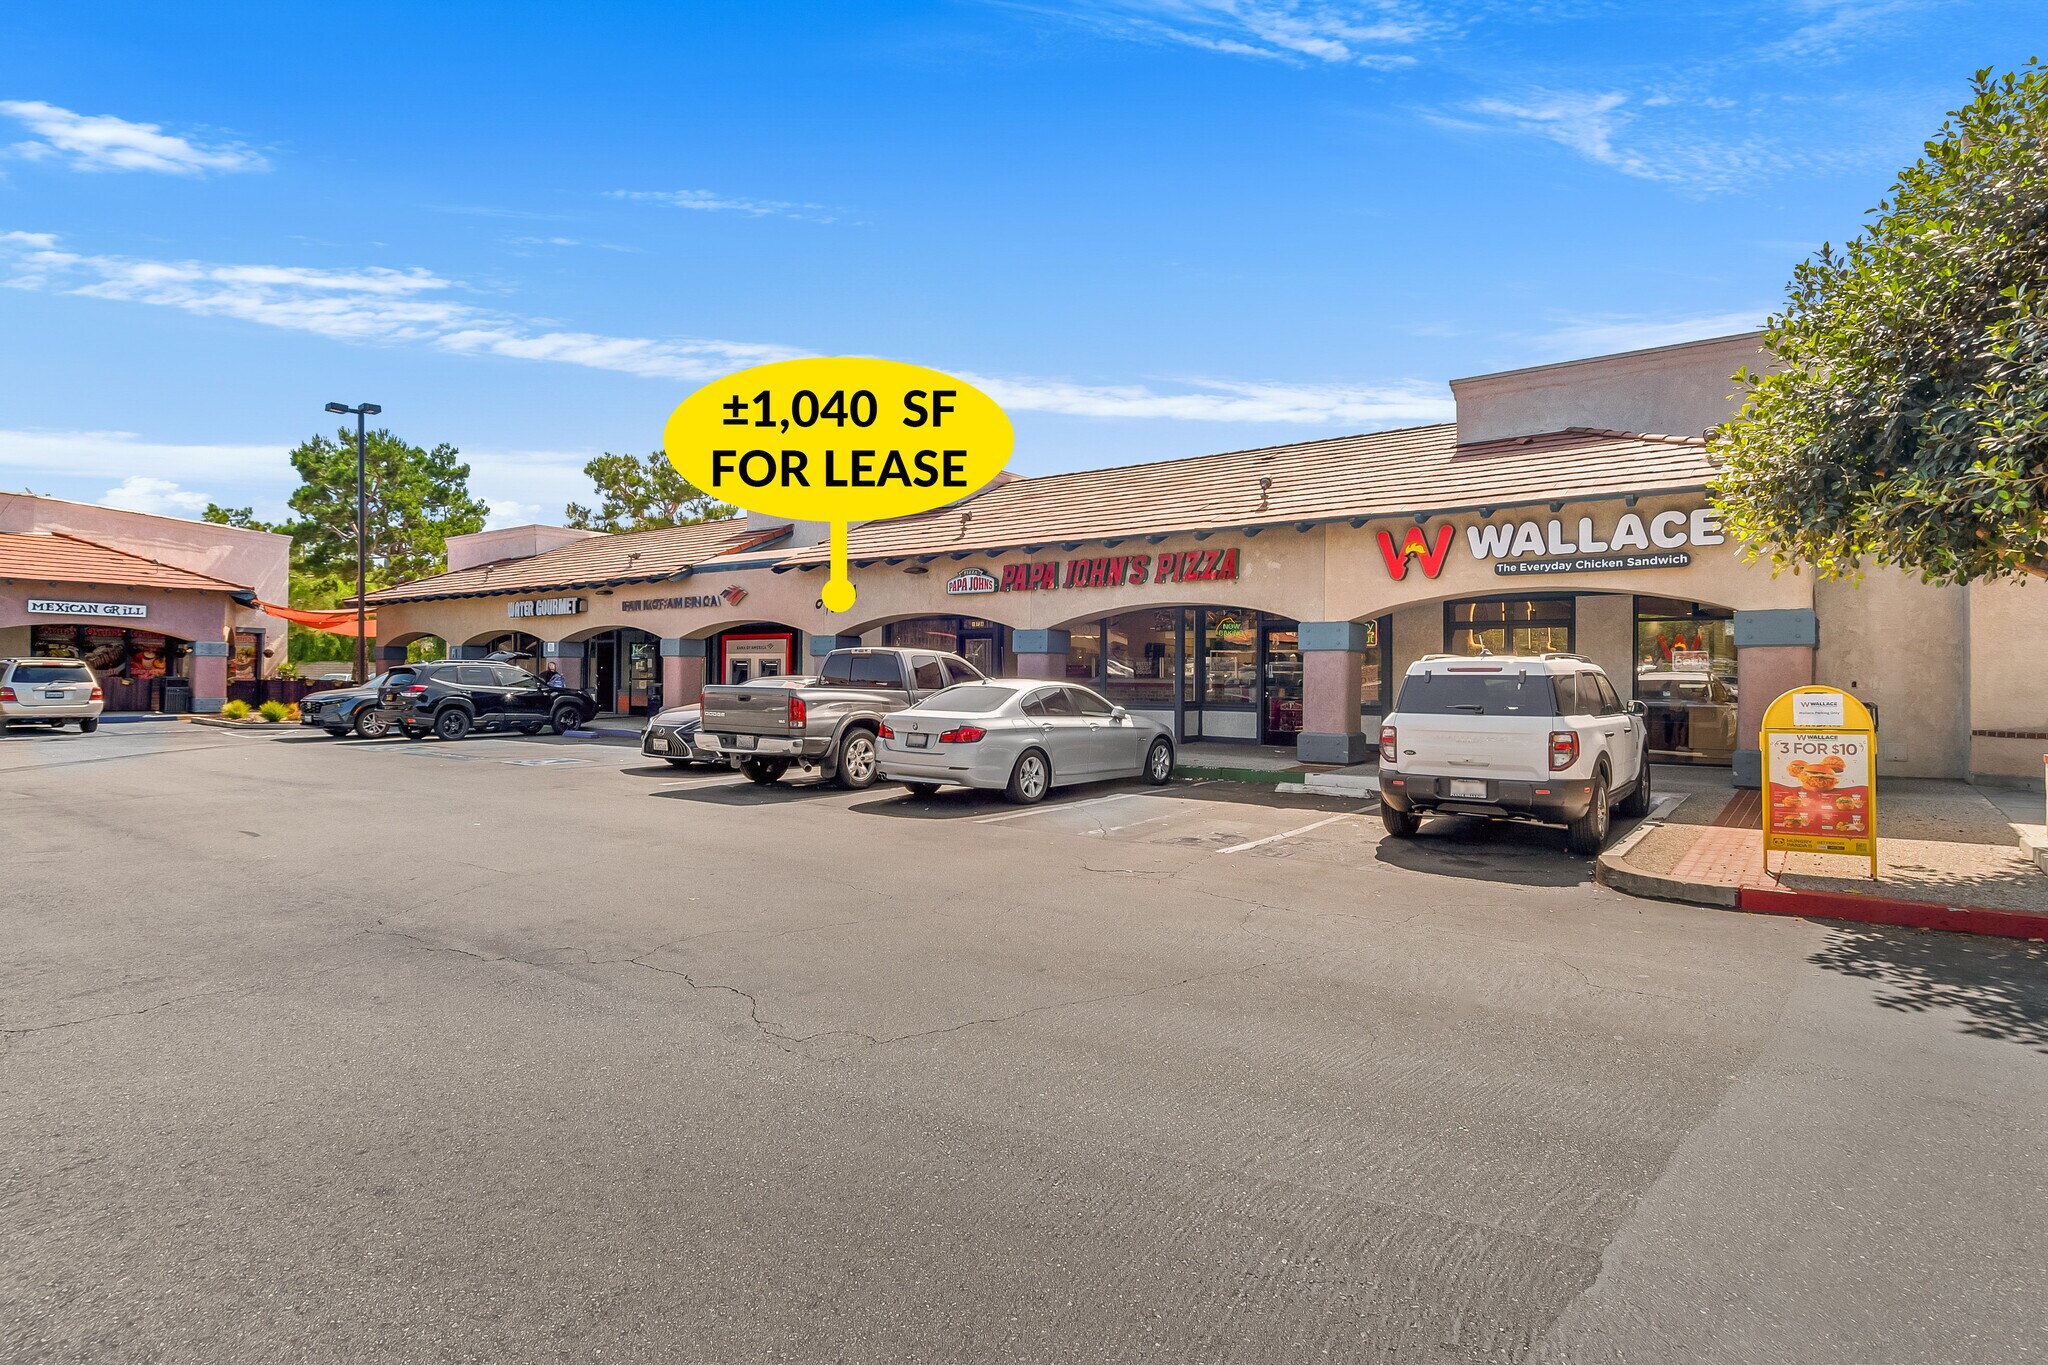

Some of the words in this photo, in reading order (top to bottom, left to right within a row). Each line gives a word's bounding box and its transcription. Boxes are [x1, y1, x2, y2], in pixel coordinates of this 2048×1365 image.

[1466, 507, 1725, 560] WALLACE
[1000, 561, 1060, 592] PAPA
[1062, 554, 1152, 590] JOHN'S
[1154, 547, 1240, 585] PIZZA
[1496, 563, 1517, 573] The
[1519, 561, 1572, 572] Everyday
[1575, 558, 1623, 570] Chicken
[1626, 553, 1688, 568] Sandwich
[948, 577, 968, 592] PAPA
[507, 600, 534, 618] WATER
[535, 597, 578, 616] GOURMET
[1780, 742, 1790, 754] 3
[1793, 742, 1828, 755] FOR
[1831, 743, 1858, 756] $10
